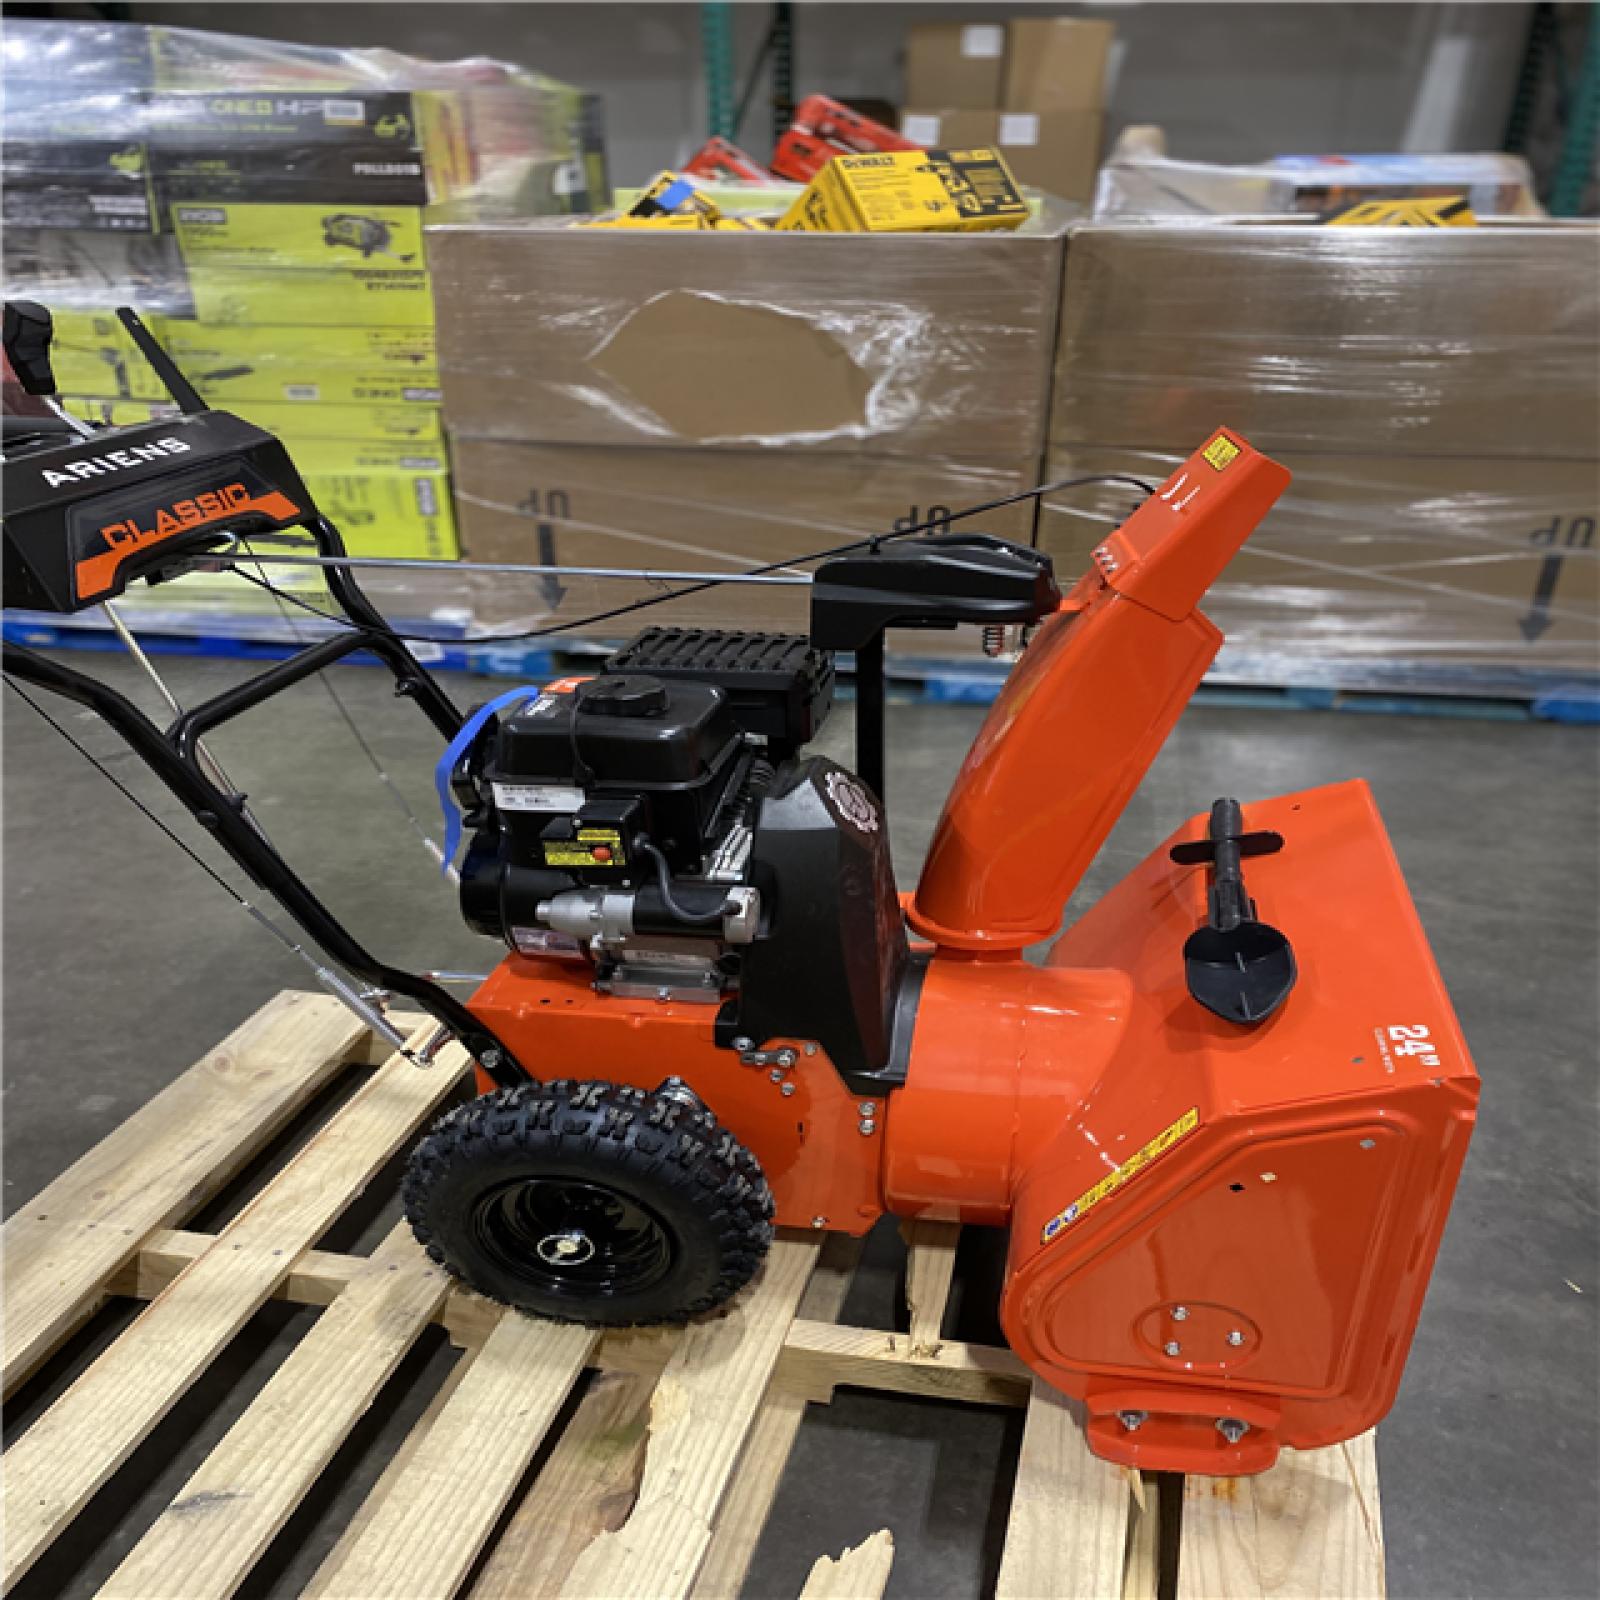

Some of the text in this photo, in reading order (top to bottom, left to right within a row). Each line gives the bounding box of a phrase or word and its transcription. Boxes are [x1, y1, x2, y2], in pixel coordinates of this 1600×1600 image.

[42, 437, 191, 487] ARIENS
[101, 483, 250, 549] CLASSIC
[516, 488, 570, 520] UP
[1528, 515, 1596, 548] UP
